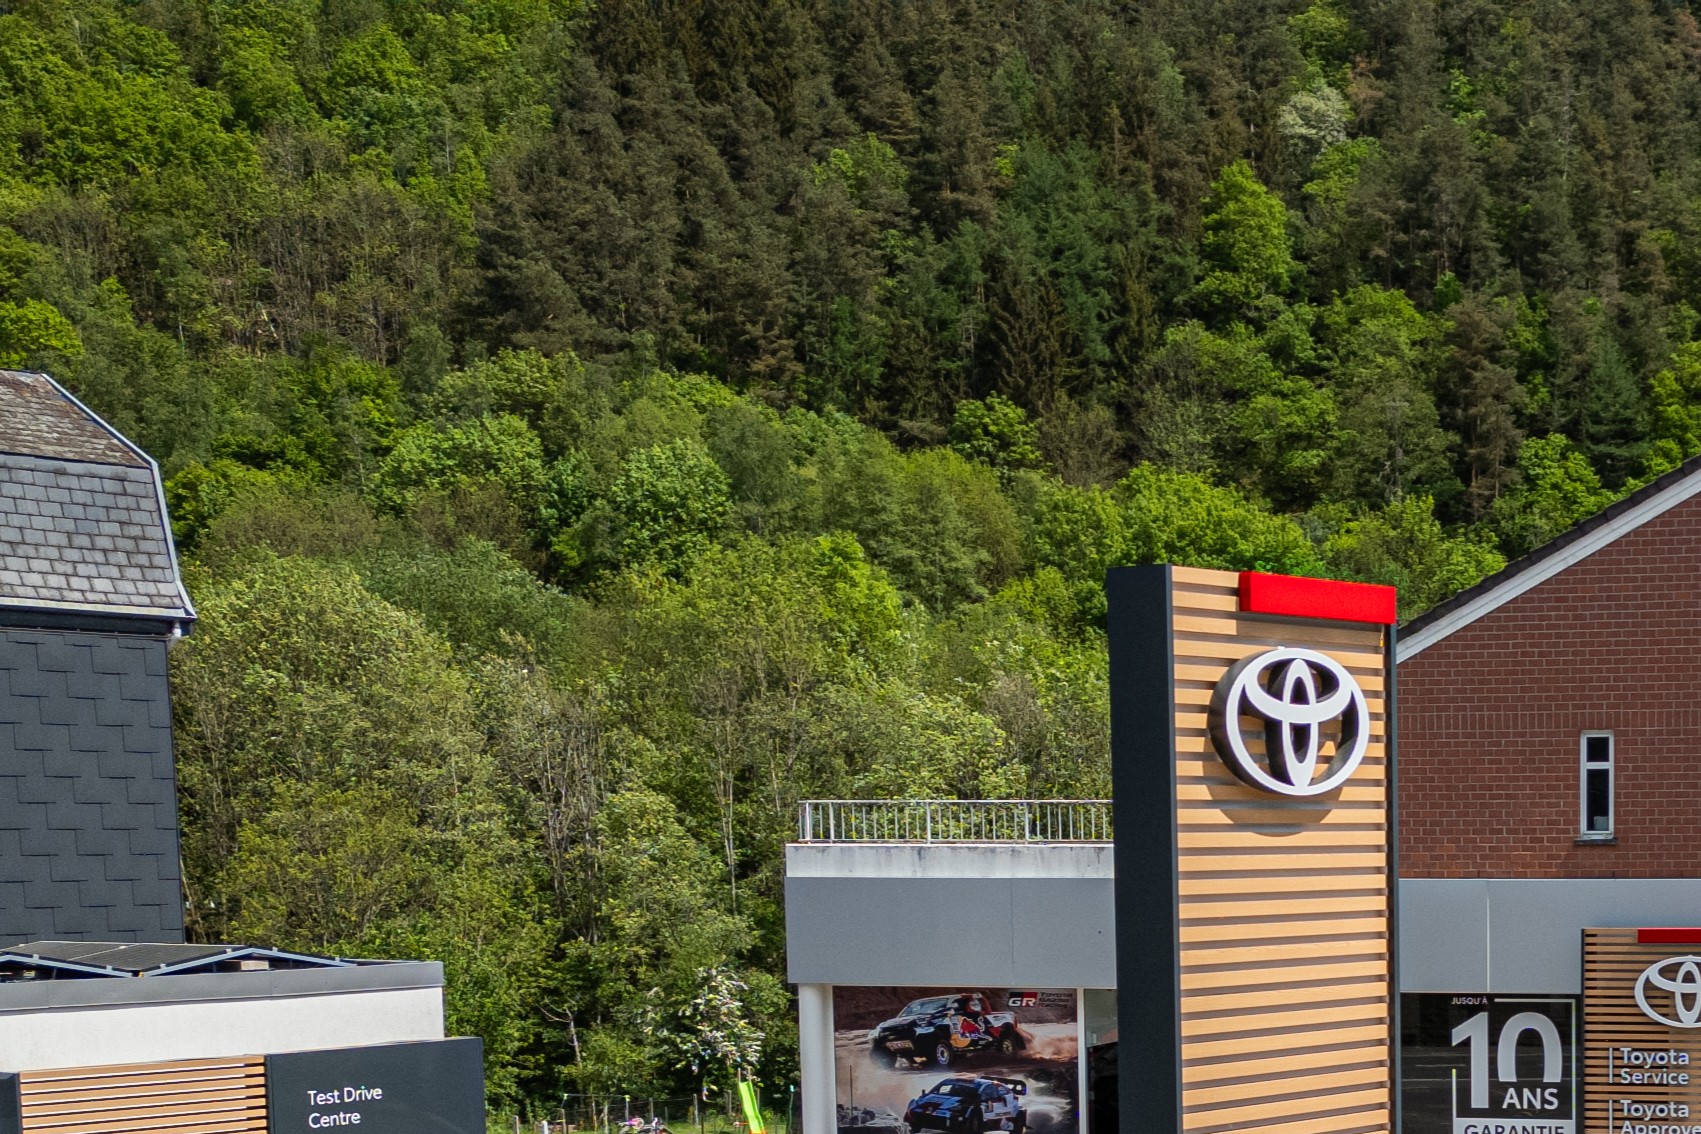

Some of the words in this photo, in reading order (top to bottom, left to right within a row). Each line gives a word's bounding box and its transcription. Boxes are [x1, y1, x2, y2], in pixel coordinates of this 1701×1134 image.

[1008, 997, 1036, 1007] GR
[1451, 996, 1488, 1005] JUSQU'À
[1451, 1011, 1563, 1109] 10
[1620, 1047, 1689, 1068] Toyota
[1620, 1068, 1689, 1085] Service
[307, 1089, 341, 1106] Test
[343, 1085, 383, 1103] Drive
[1502, 1087, 1559, 1110] ANS
[308, 1111, 361, 1129] Centre
[1620, 1099, 1689, 1121] Toyota
